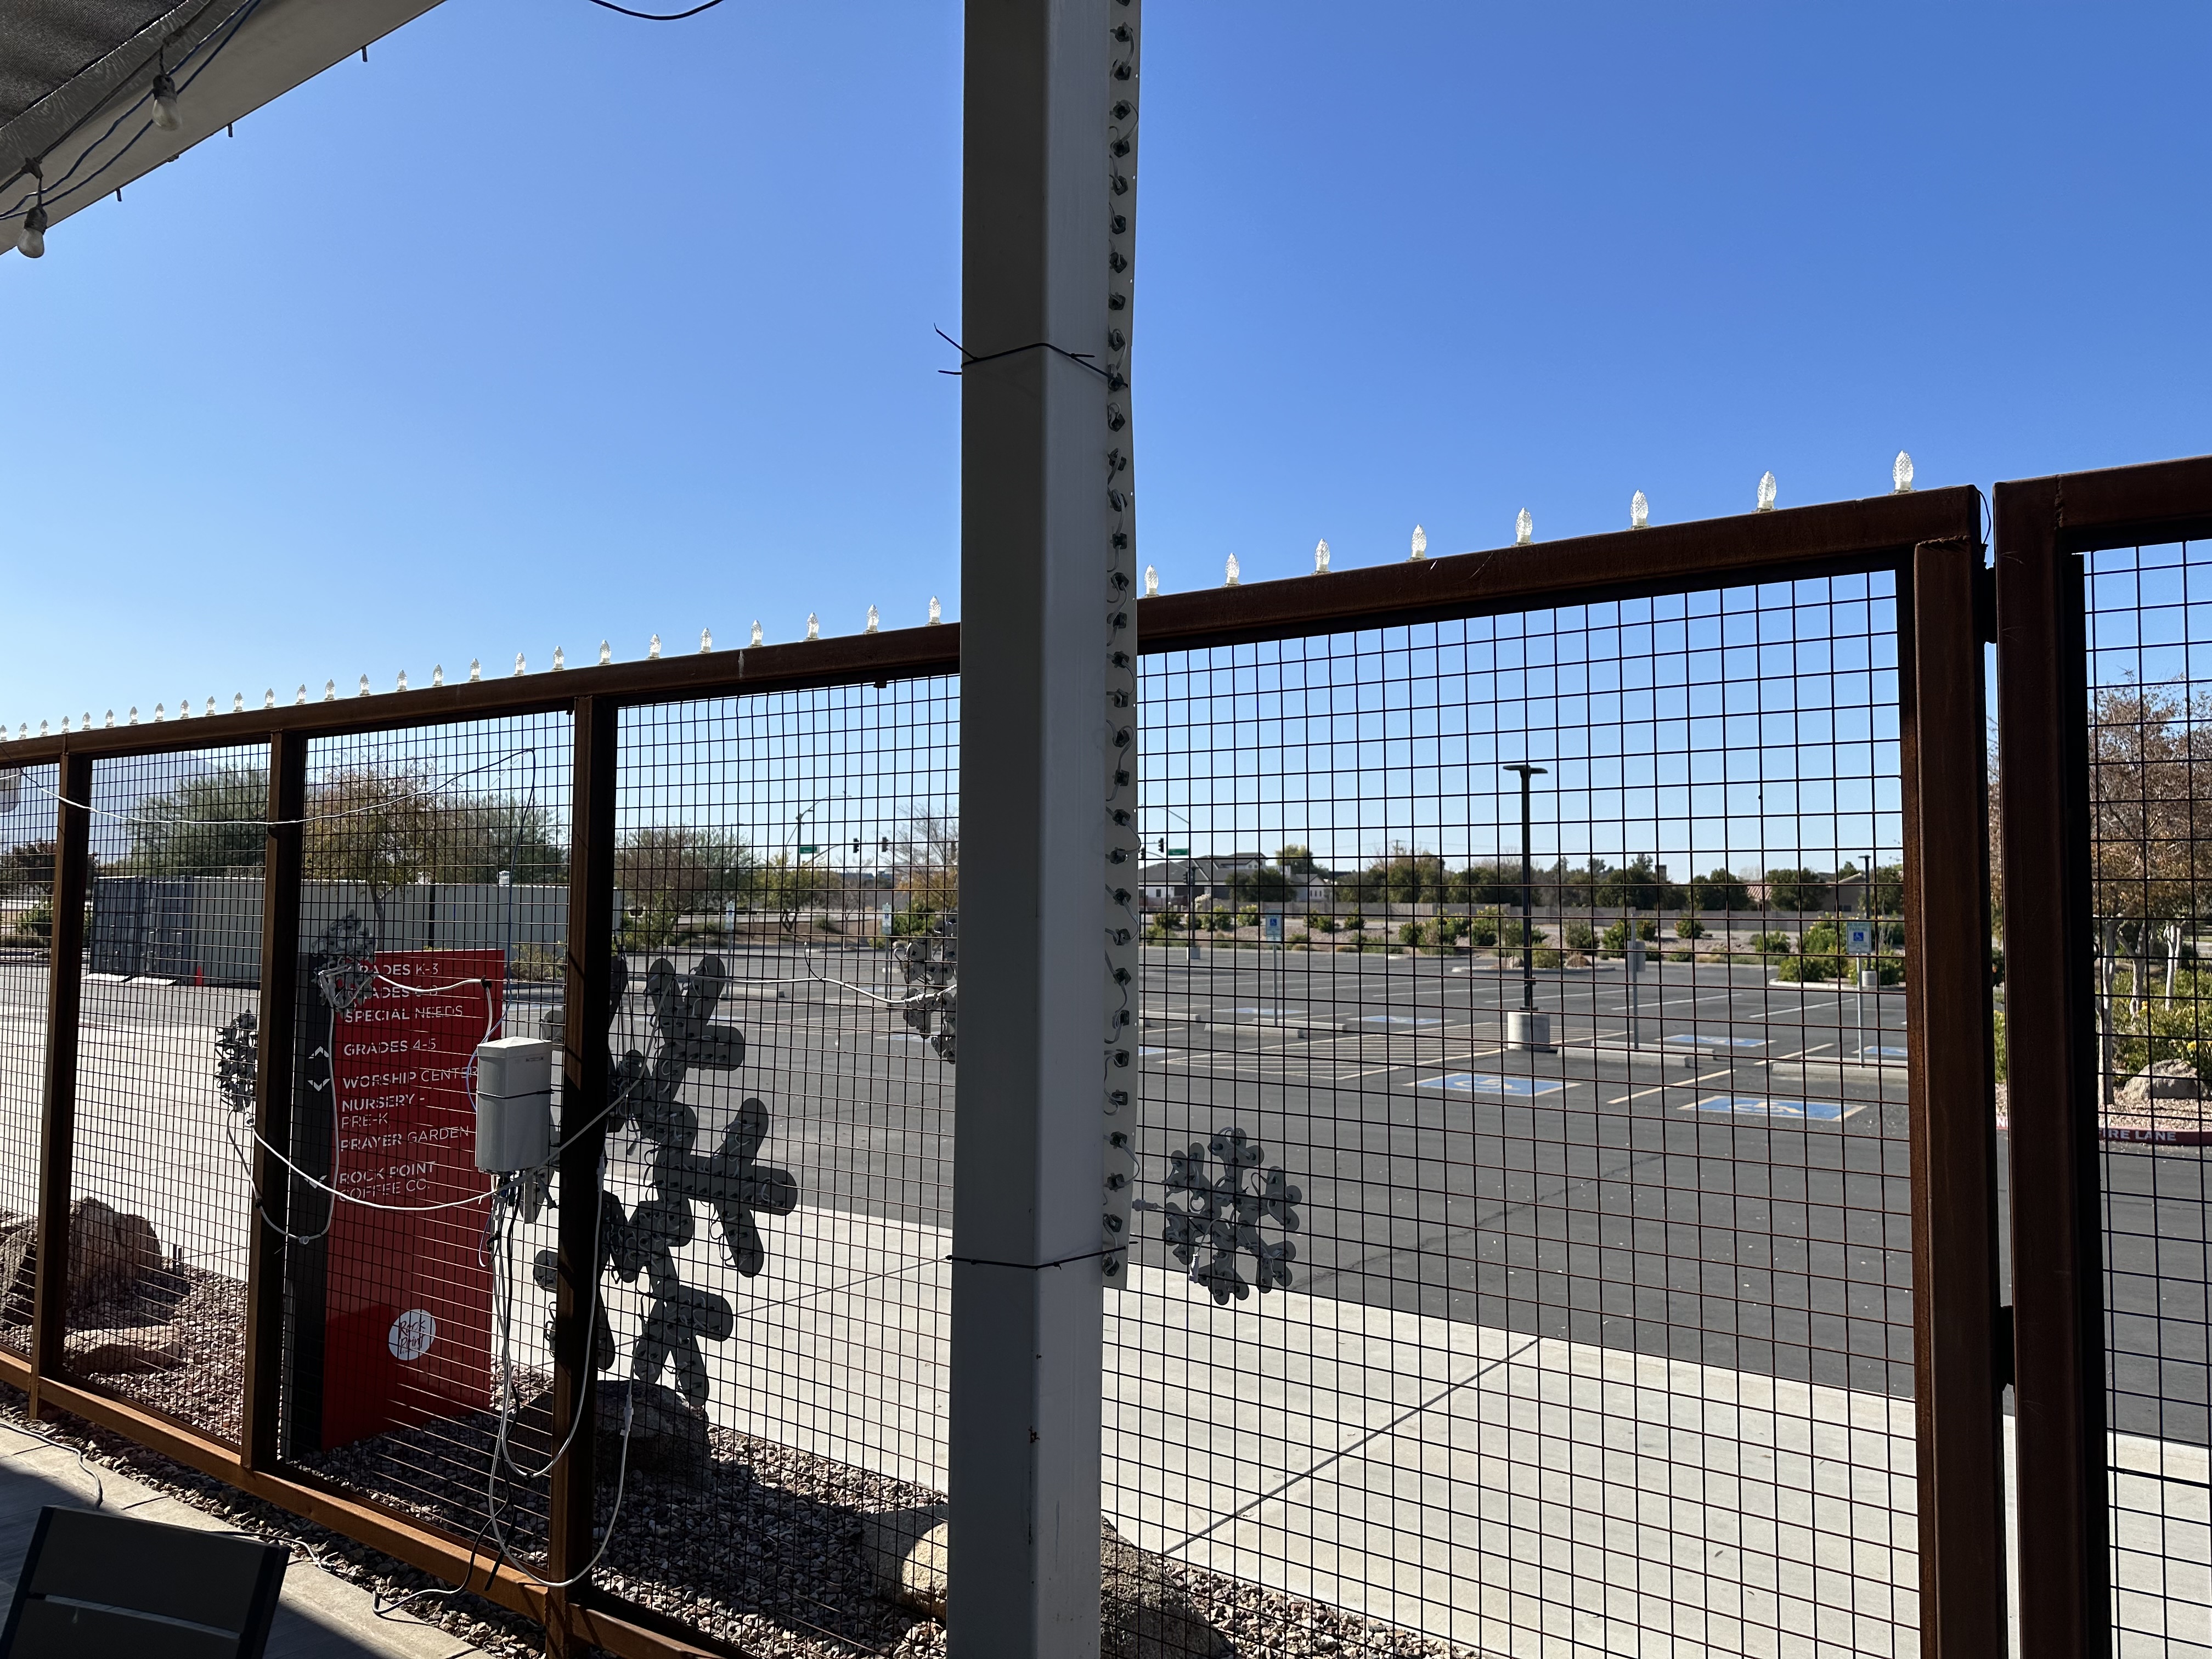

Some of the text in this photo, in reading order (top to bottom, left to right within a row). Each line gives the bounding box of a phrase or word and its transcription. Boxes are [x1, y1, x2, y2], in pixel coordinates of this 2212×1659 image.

[347, 963, 438, 975] RADES K-3
[415, 985, 438, 997] 68
[345, 1005, 463, 1023] SPECIAL NEEDS
[344, 1038, 436, 1056] GRADES 4-5
[343, 1066, 478, 1089] WORSHIP CENTER
[342, 1093, 415, 1112] NURSERY
[341, 1113, 388, 1129] PRE-K
[341, 1126, 469, 1152] PRAYER GARDEN
[2135, 1130, 2176, 1141] LANE
[340, 1161, 436, 1184] ROCK POINT
[338, 1178, 430, 1201] COFFEE CO.
